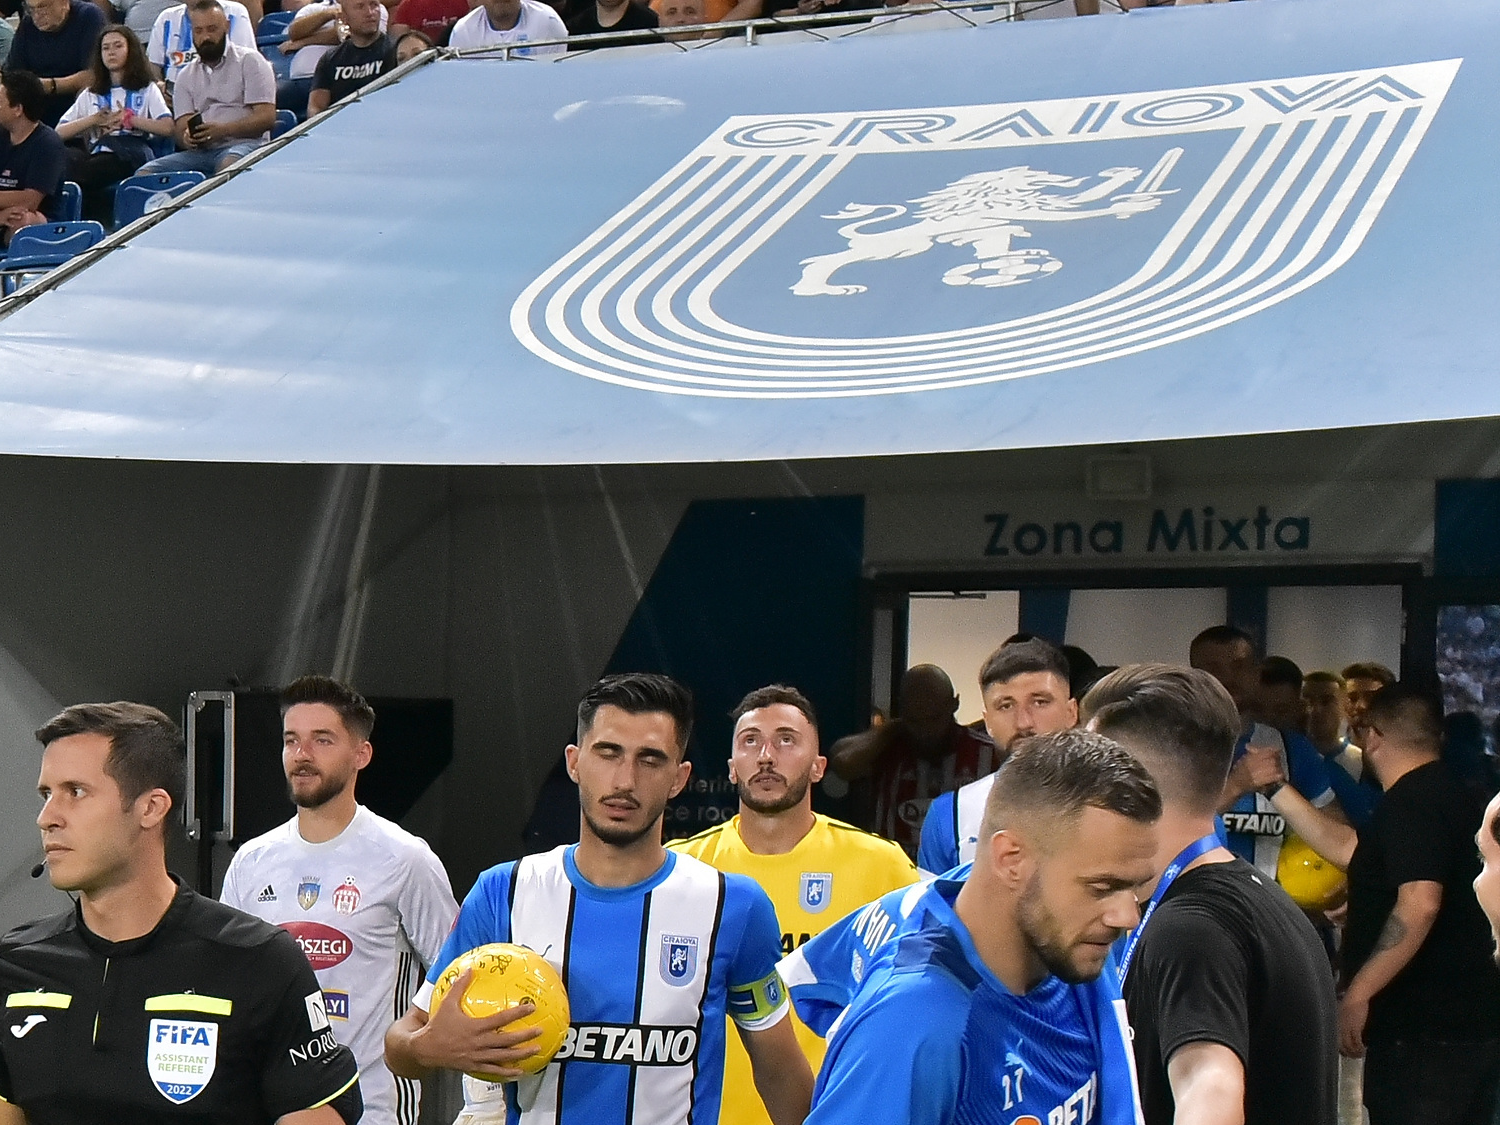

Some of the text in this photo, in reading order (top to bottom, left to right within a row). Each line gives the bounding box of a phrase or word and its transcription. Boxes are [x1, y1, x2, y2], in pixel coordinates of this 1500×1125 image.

[723, 75, 1426, 149] CRAIOVA
[984, 506, 1311, 558] Zona Mixta
[155, 1024, 211, 1047] FIFA
[557, 1026, 697, 1063] BETANO
[154, 1053, 210, 1066] ASSISTANT
[157, 1063, 205, 1075] REFEREE
[166, 1084, 193, 1096] 2022
